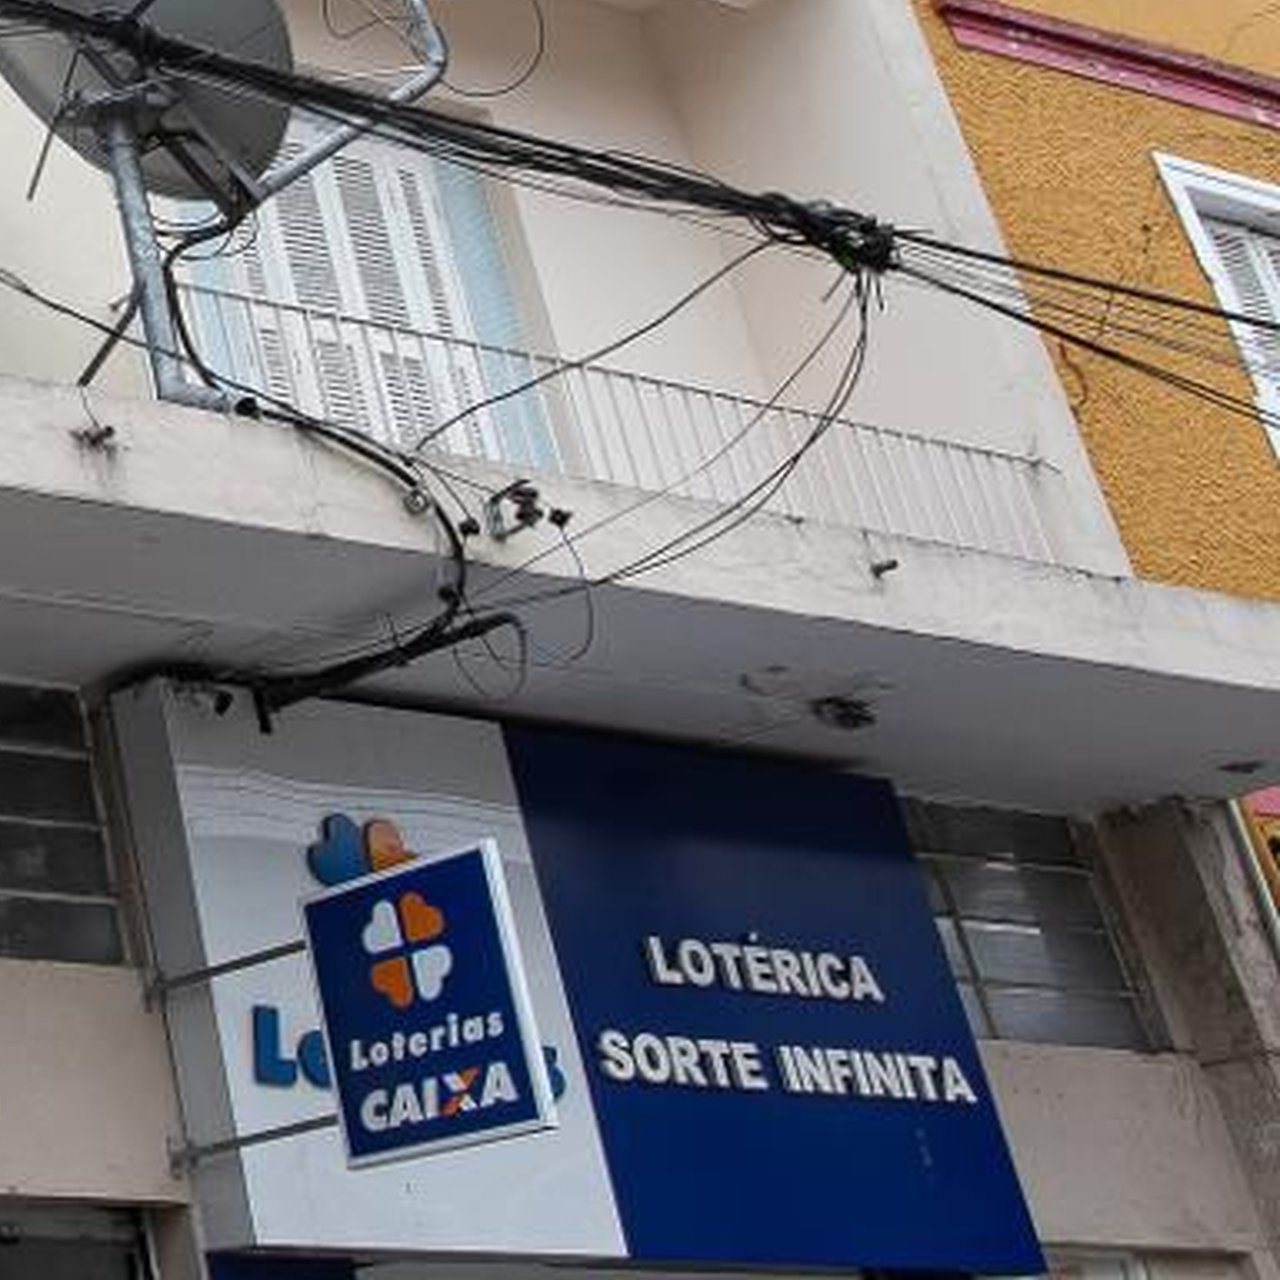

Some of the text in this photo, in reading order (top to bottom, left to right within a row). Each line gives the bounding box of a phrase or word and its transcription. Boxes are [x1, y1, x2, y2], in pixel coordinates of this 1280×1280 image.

[646, 932, 887, 1003] LOTÉRICA
[350, 1011, 506, 1071] Loterias
[598, 1028, 770, 1091] SORTE
[774, 1045, 978, 1104] INFINITA
[360, 1061, 519, 1133] CAIXA
